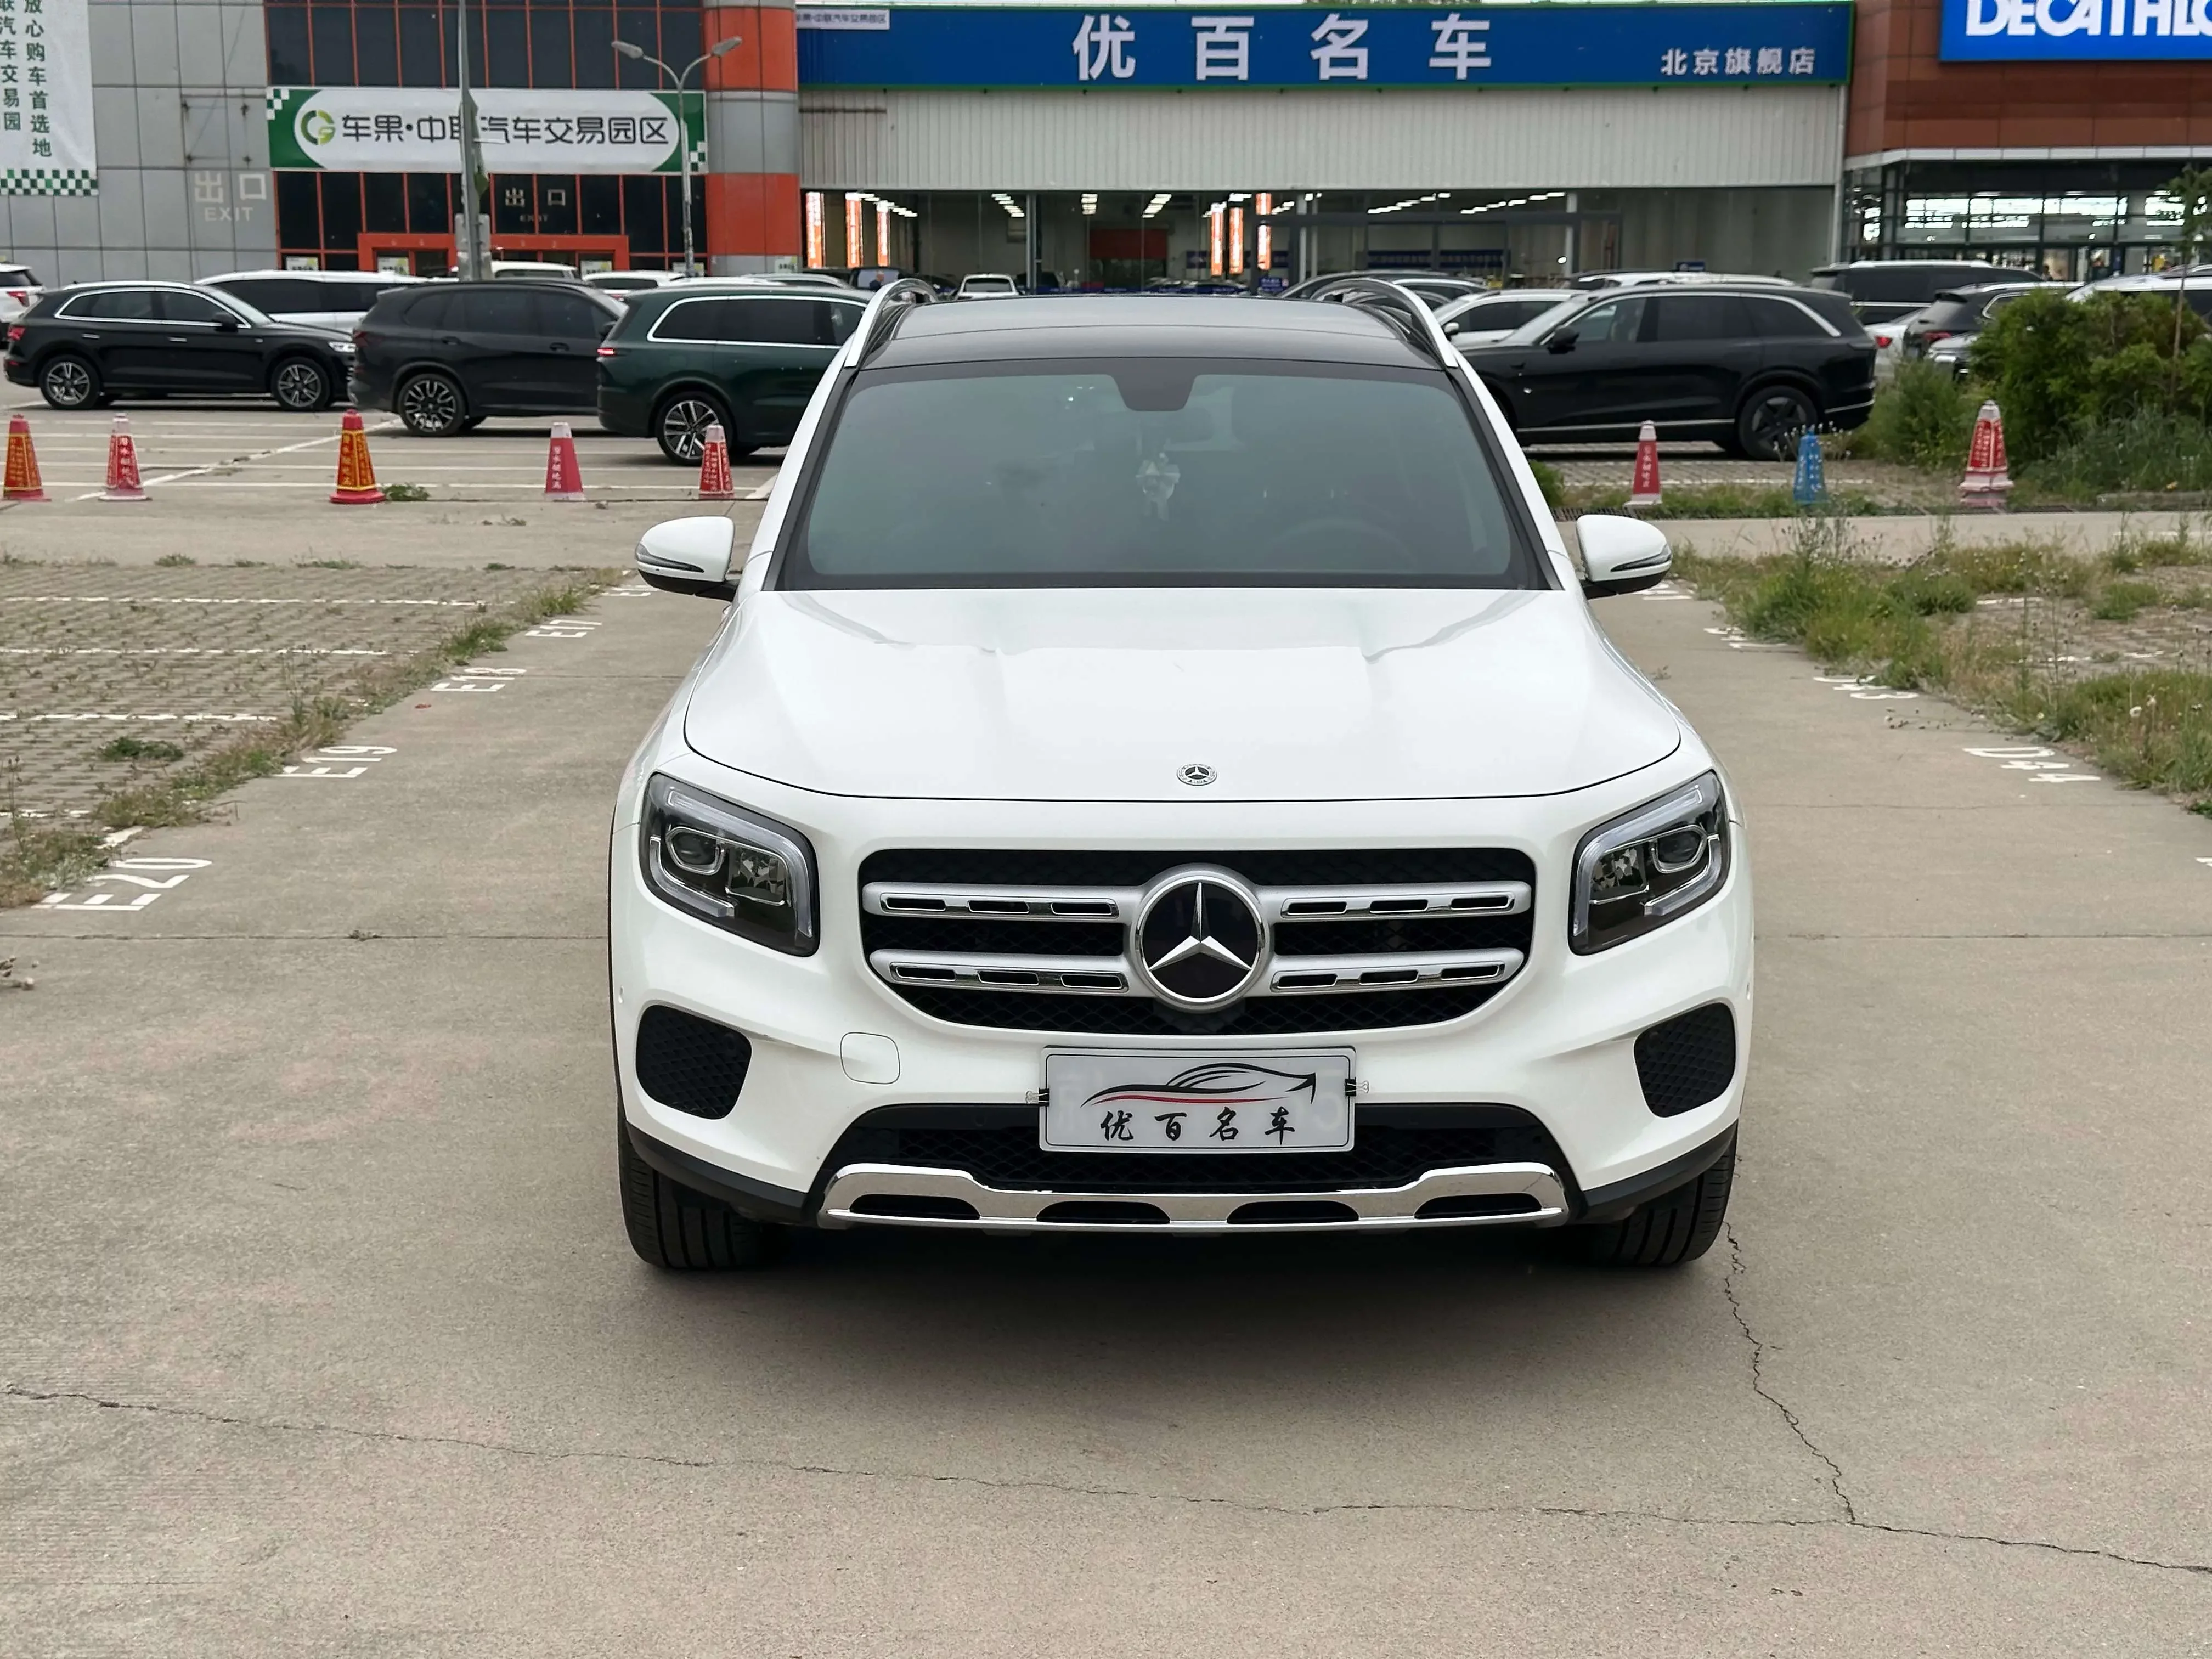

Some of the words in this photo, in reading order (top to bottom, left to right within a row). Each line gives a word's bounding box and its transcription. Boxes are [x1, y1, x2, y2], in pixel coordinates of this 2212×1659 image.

[1073, 13, 1491, 81] 优百名车
[1661, 48, 1814, 76] 北京旗舰店
[25, 0, 52, 157] 放心购车首选地
[194, 170, 267, 203] 出口
[505, 187, 566, 207] 出口
[204, 207, 253, 222] EXIT
[524, 619, 602, 638] E17
[430, 667, 527, 692] E18
[273, 746, 398, 778] E19
[1962, 746, 2101, 783] D44
[31, 857, 213, 911] E20
[1101, 1107, 1295, 1146] 优百名车
